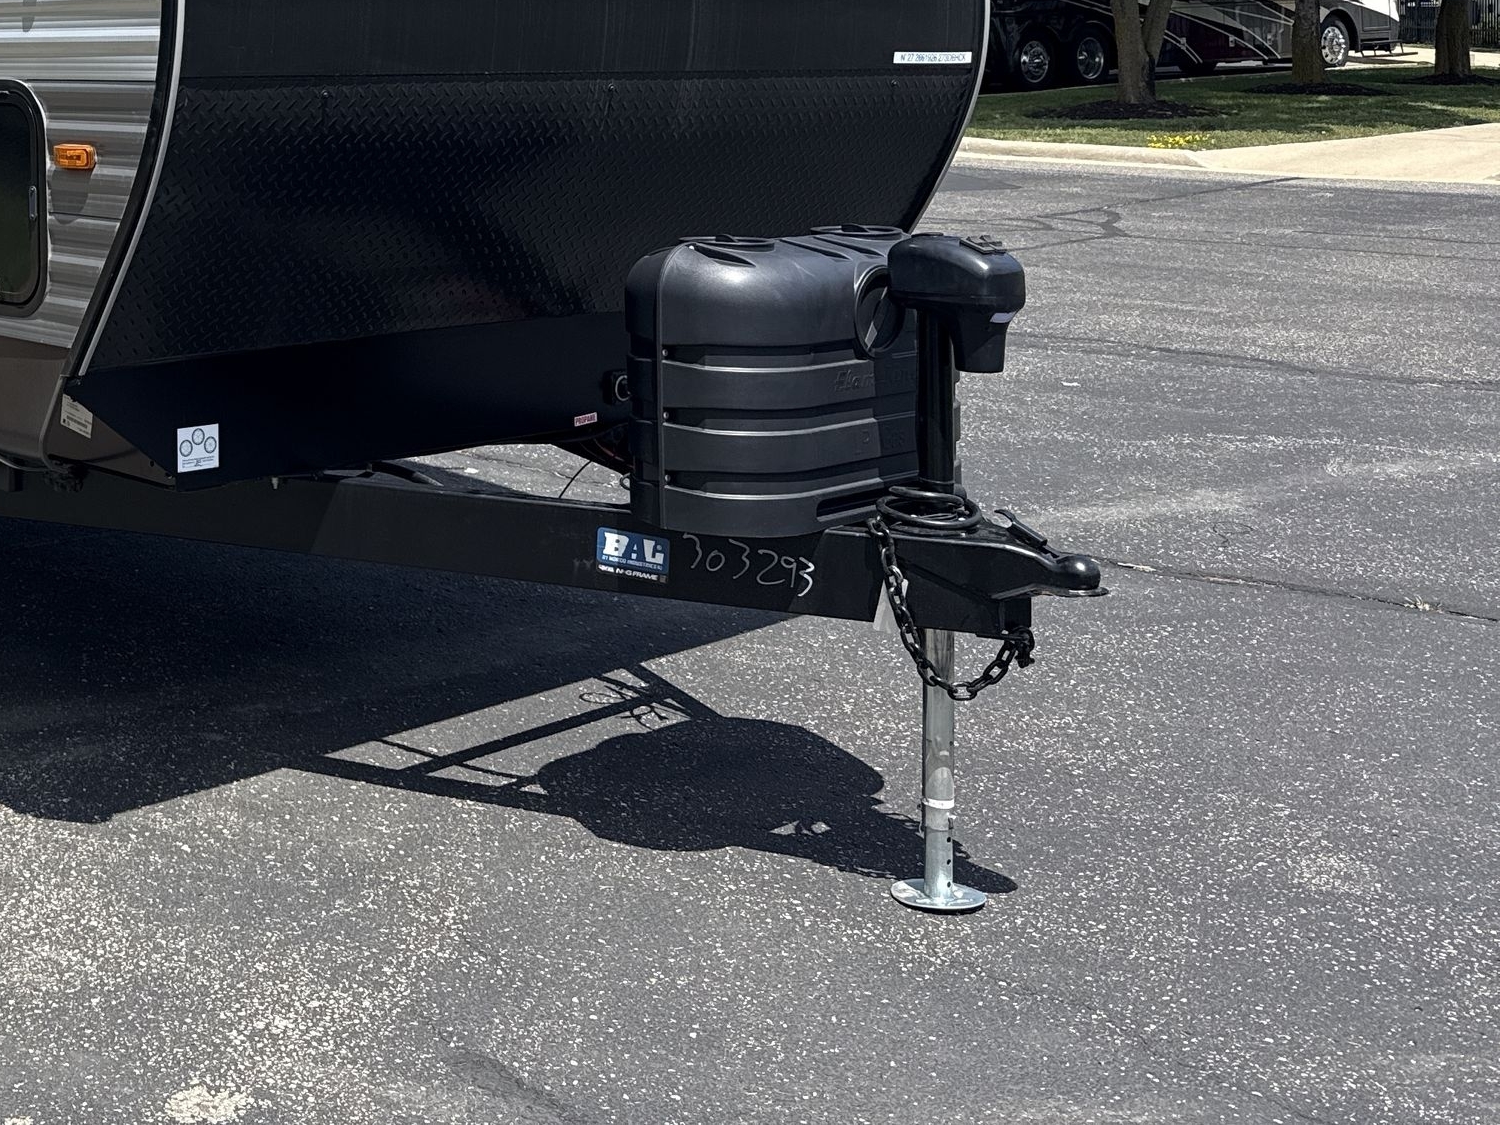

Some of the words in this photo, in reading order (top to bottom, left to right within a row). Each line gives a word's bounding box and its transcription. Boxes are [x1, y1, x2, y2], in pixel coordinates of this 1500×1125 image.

[603, 532, 665, 564] BAL
[633, 571, 659, 581] FRAME
[683, 533, 815, 596] 303293
